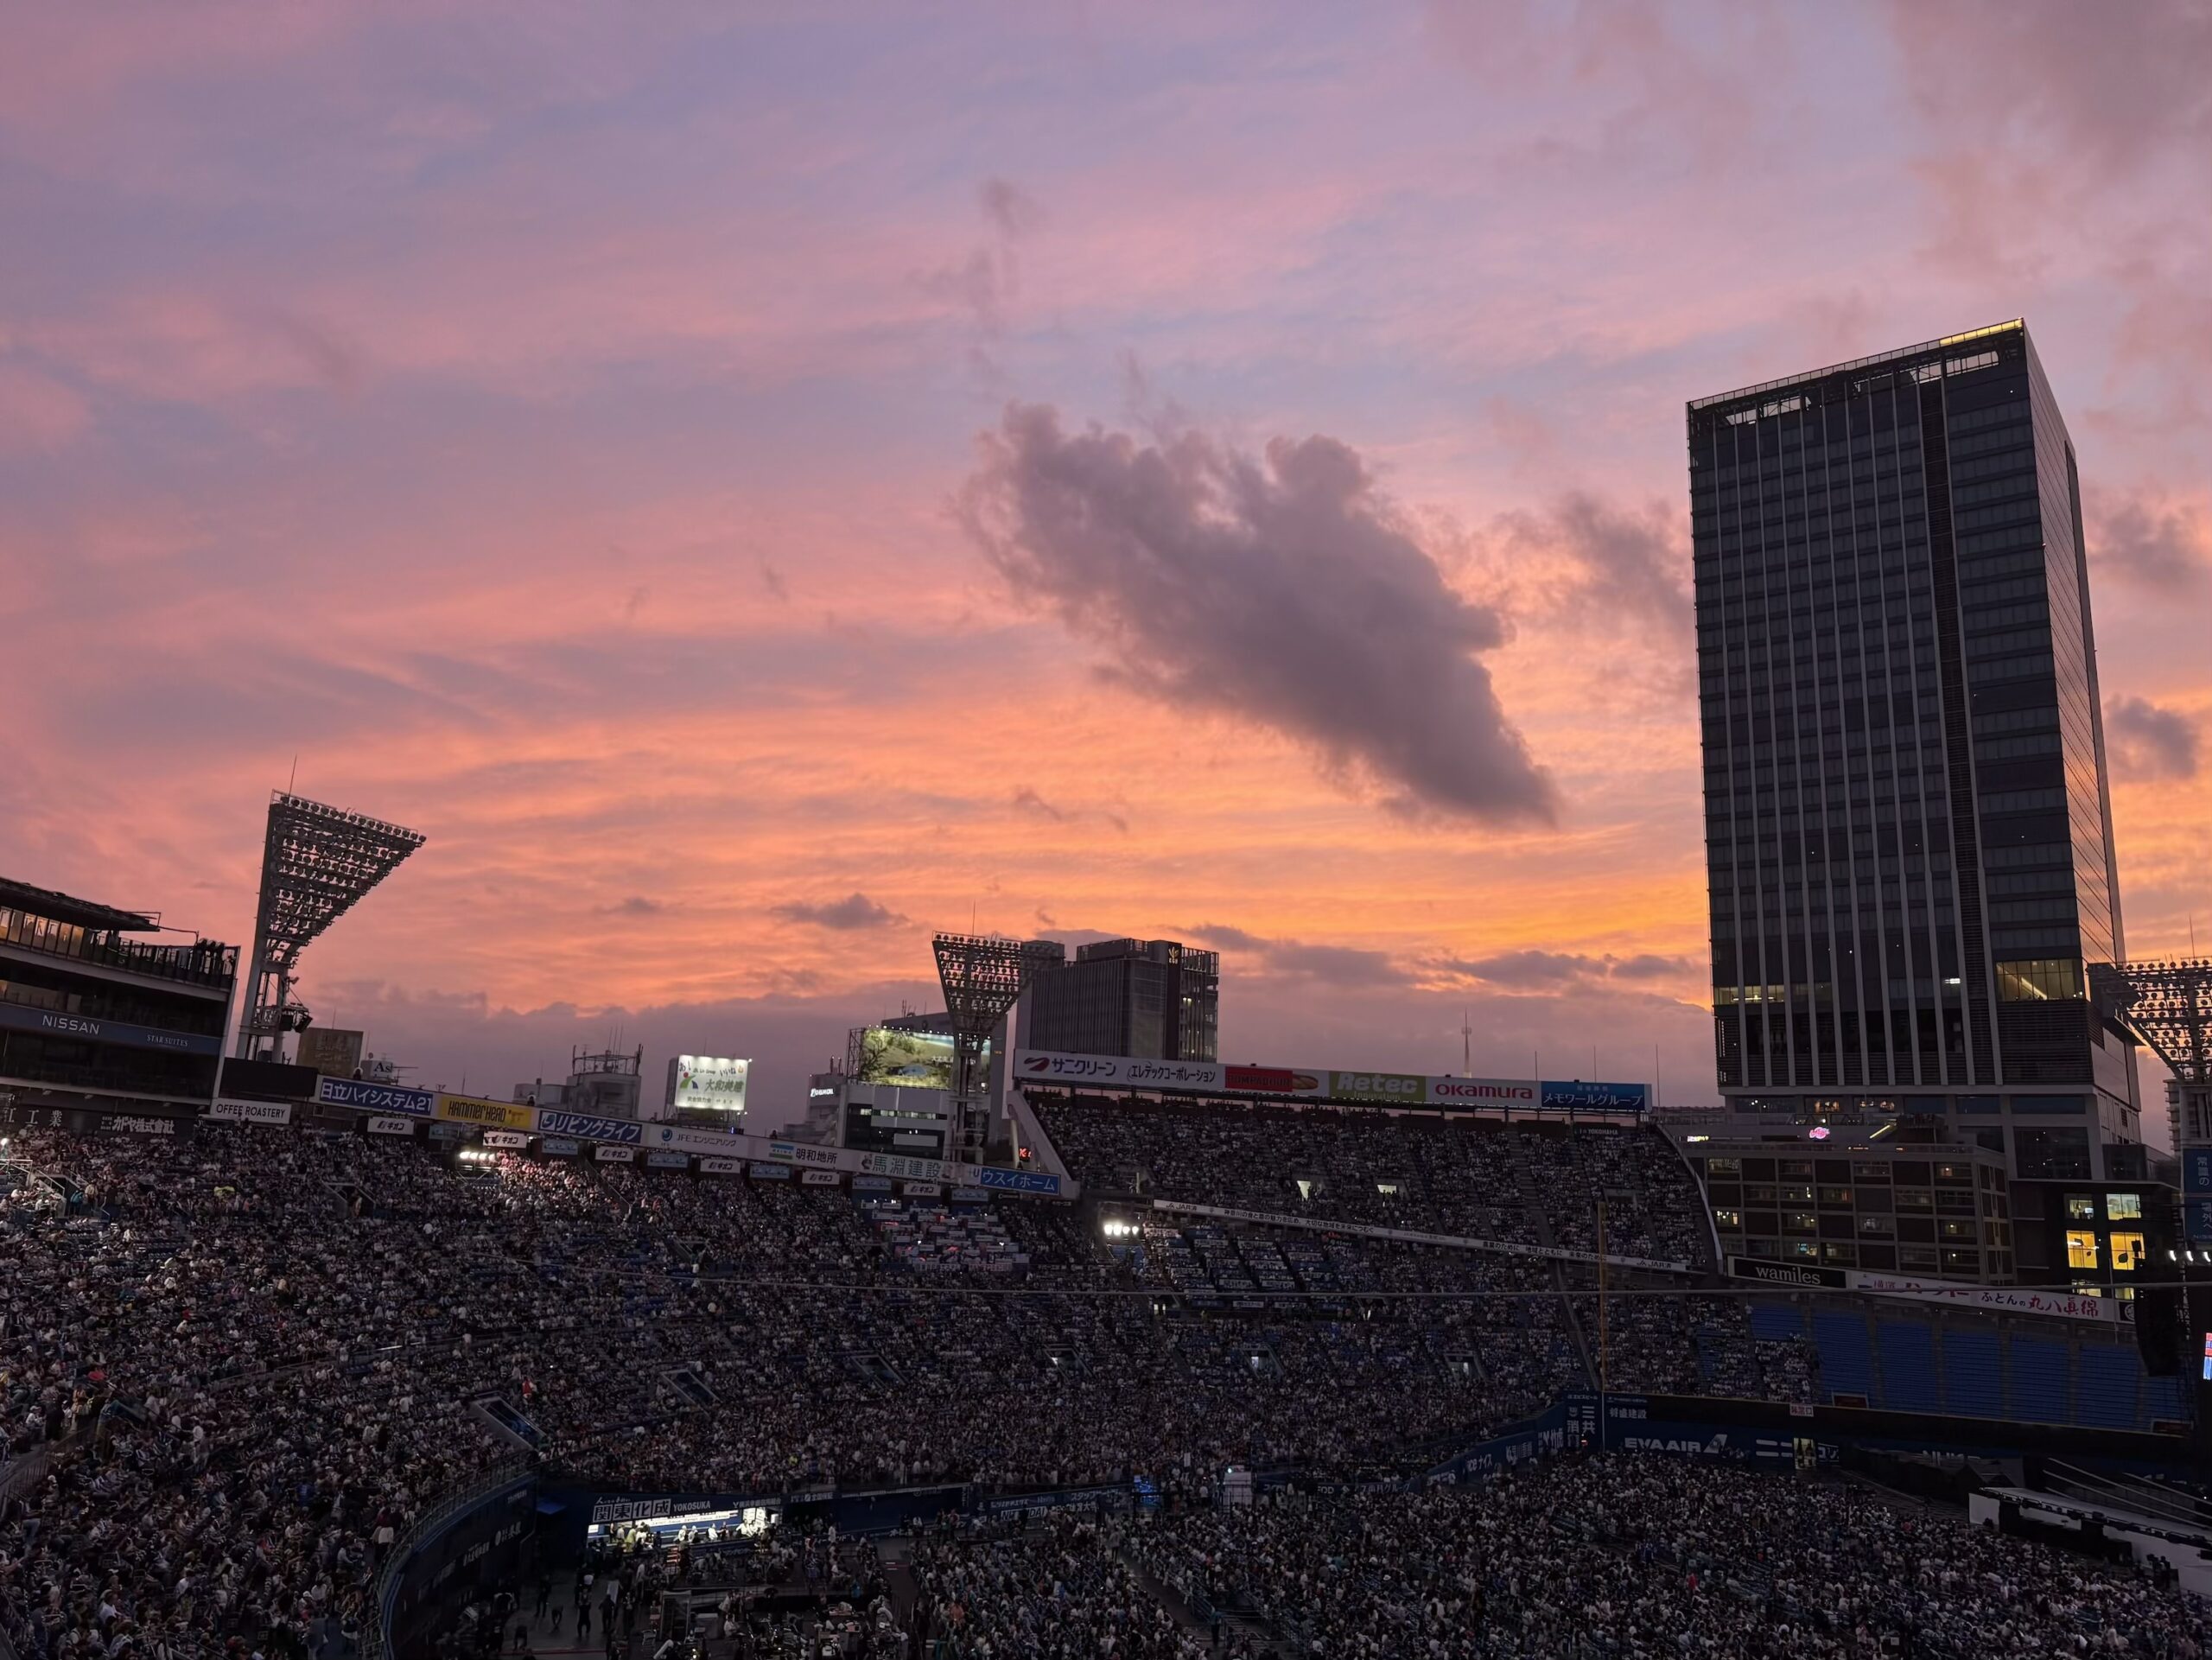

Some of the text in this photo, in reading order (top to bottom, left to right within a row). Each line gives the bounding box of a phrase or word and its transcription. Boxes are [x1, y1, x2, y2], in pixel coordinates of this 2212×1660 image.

[42, 1014, 100, 1034] NISSAN
[1052, 1058, 1116, 1077] サニクリーン
[1131, 1065, 1216, 1083] エレテックコーポレーション
[1337, 1072, 1418, 1093] Retec
[320, 1082, 432, 1113] 日立ハイシステム21
[1542, 1092, 1643, 1106] メモワールグループ
[245, 1107, 285, 1118] ROASTERY
[556, 1114, 640, 1142] リビングライフ
[676, 1132, 691, 1142] JFE
[796, 1148, 837, 1164] 明和地所
[982, 1169, 1055, 1192] ウスイホーム
[1756, 1267, 1821, 1285] wamiles
[1624, 1437, 1701, 1453] EVA AIR
[594, 1498, 671, 1523] 関東化成
[674, 1500, 711, 1512] YOKOSUKA
